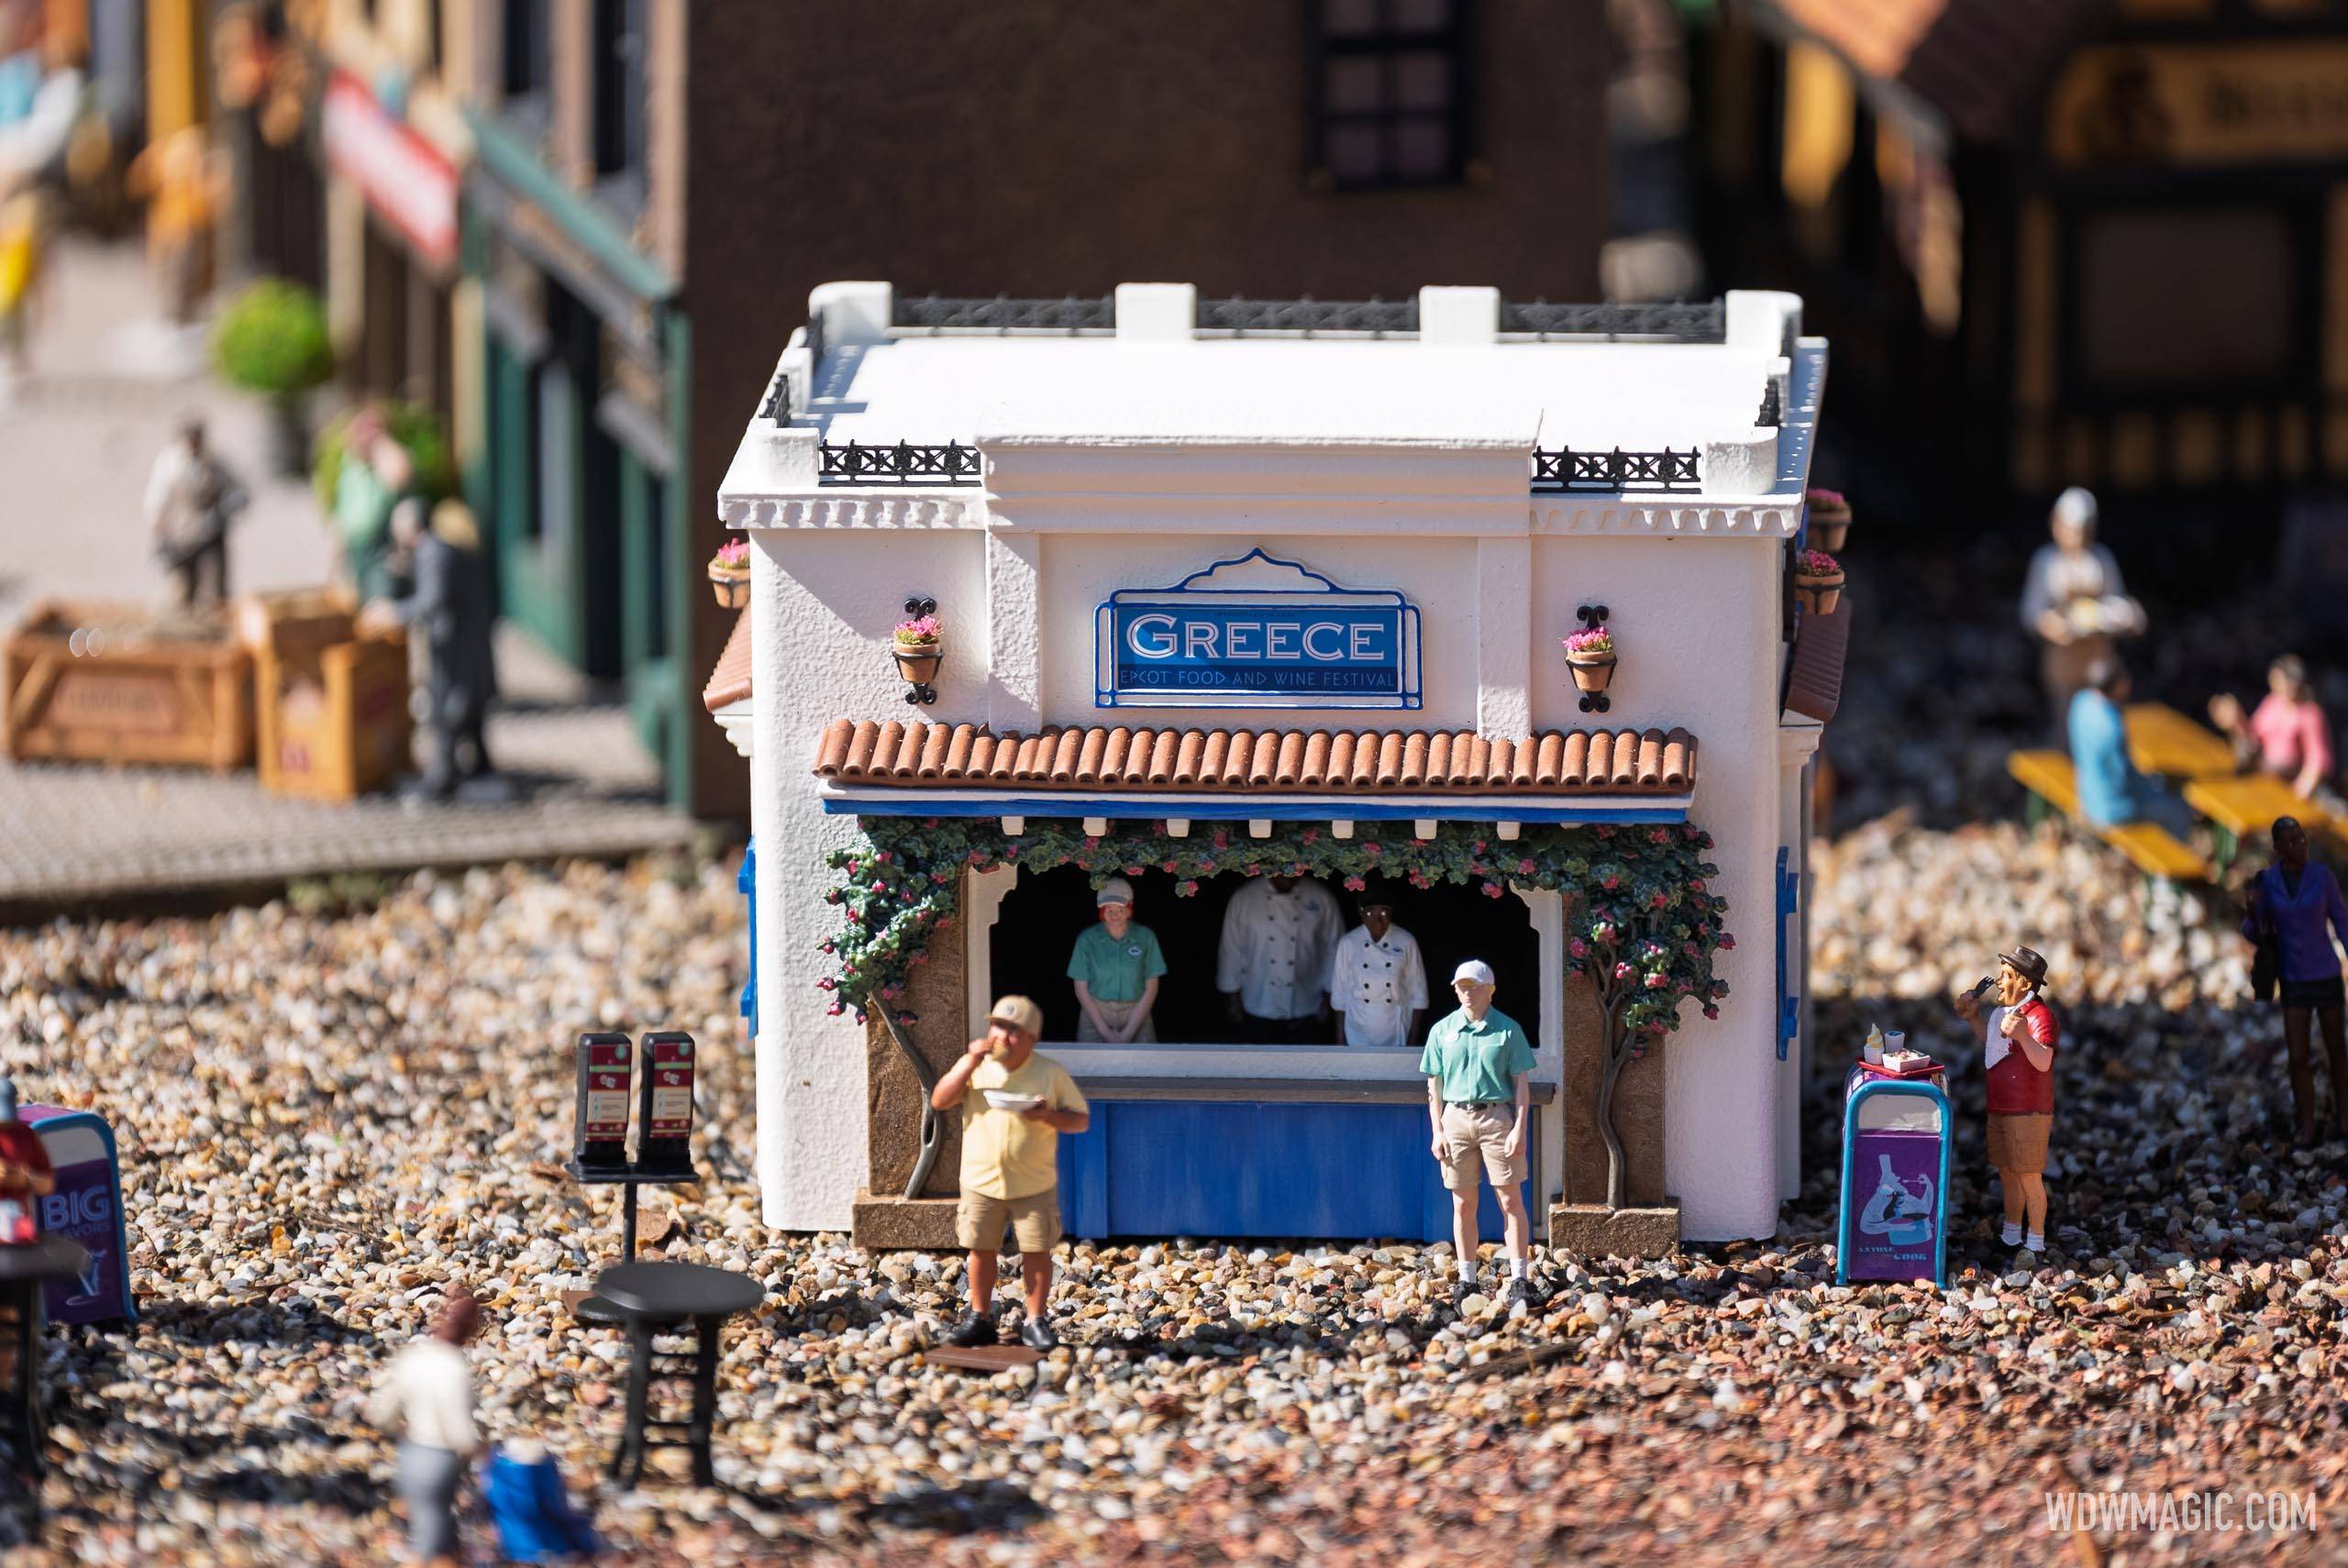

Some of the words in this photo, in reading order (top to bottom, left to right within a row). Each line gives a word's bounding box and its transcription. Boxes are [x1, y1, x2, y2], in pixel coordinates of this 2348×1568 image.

[1126, 613, 1385, 660] GREECE
[1120, 669, 1172, 685] EPCOT
[1179, 670, 1225, 686] FOOD
[1233, 671, 1268, 686] AND
[1274, 671, 1318, 687] WINE
[1324, 672, 1395, 688] FESTIVAL
[43, 1185, 110, 1231] BIG
